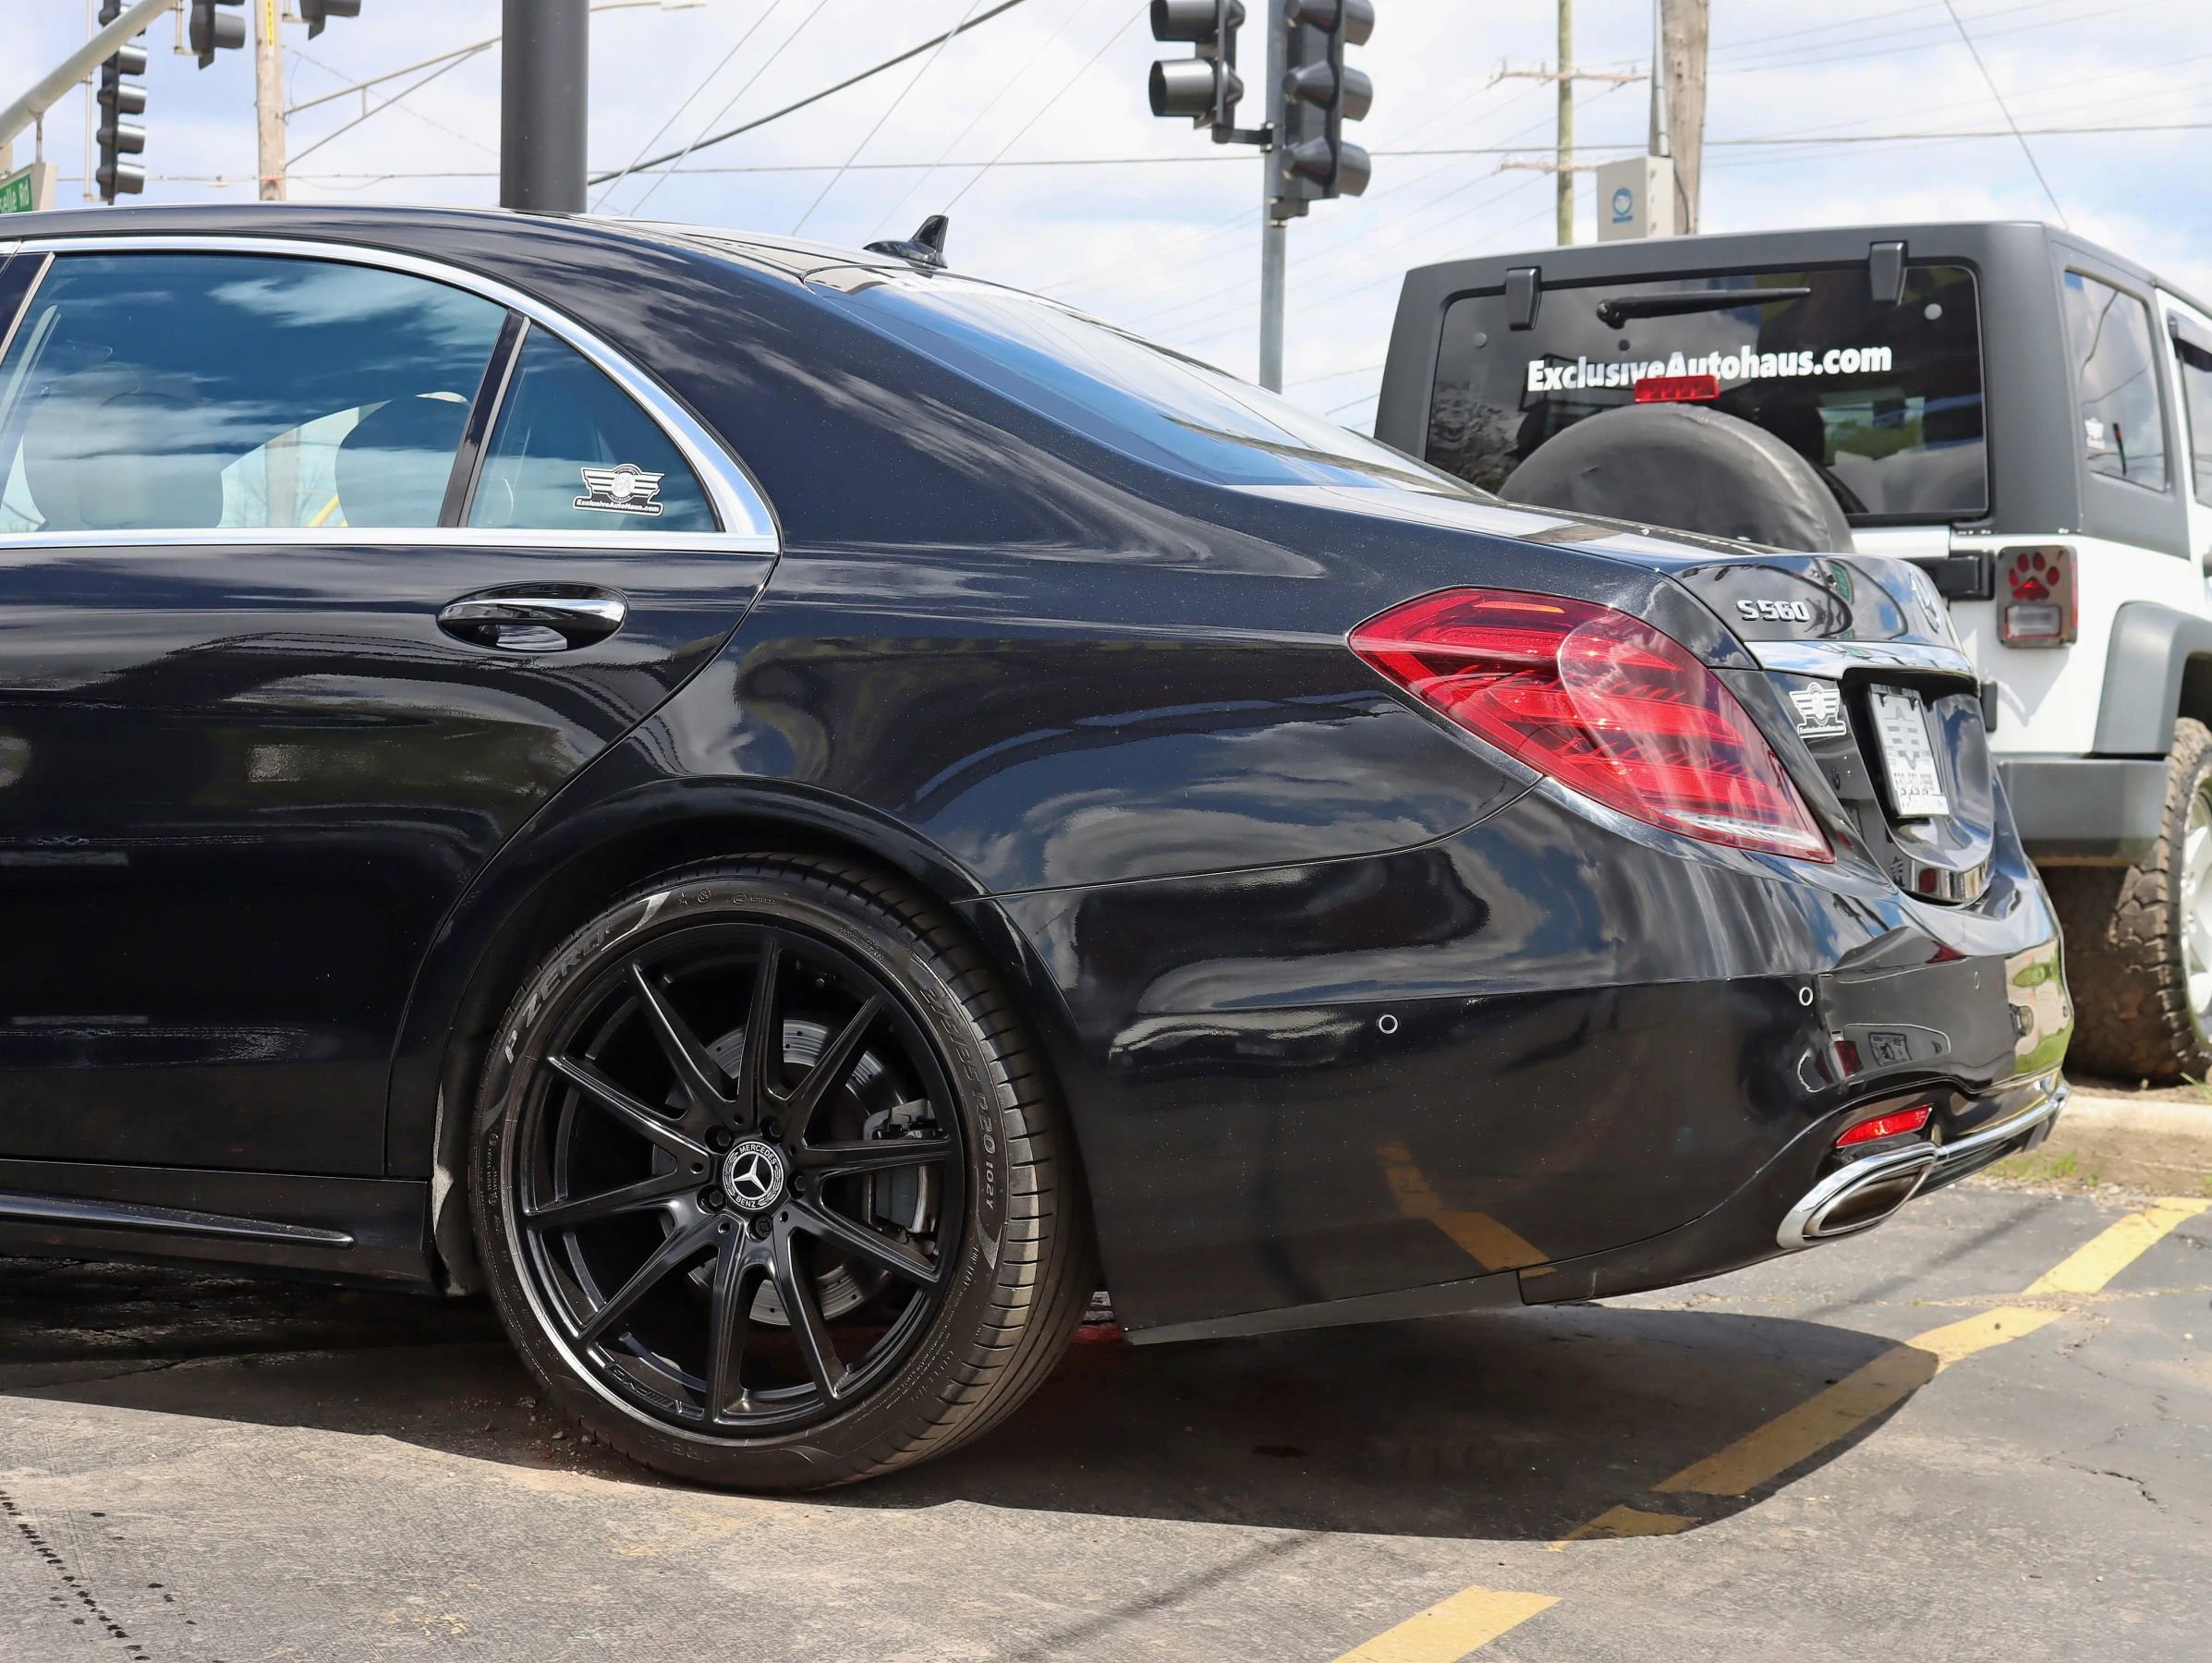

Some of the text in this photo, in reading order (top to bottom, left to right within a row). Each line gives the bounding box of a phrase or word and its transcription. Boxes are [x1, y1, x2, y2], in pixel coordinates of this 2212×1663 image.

[18, 178, 30, 208] Rd
[1527, 346, 1891, 392] ExclusiveAutohaus.com
[739, 1144, 777, 1164] MERCEDES
[735, 1196, 757, 1208] BENZ
